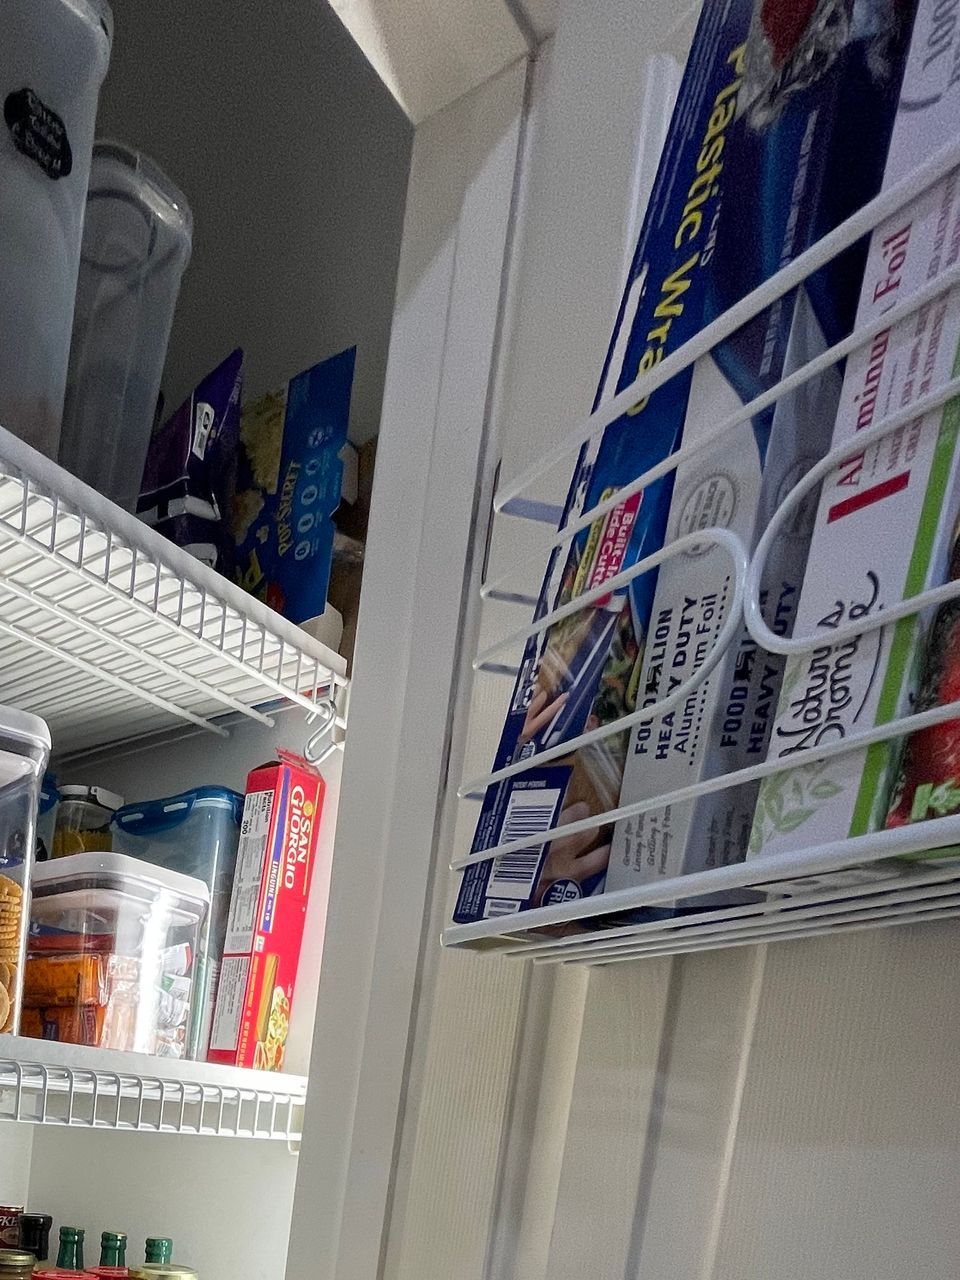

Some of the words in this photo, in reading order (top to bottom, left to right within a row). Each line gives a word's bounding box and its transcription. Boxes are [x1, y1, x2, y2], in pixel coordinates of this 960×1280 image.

[874, 221, 912, 304] Foil
[606, 501, 625, 539] lide
[651, 608, 673, 663] LION
[696, 594, 718, 636] Foil
[655, 676, 682, 760] HEAY
[672, 595, 698, 669] DUTY
[720, 687, 749, 748] FOOD
[747, 665, 779, 755] HEAVY
[285, 785, 305, 889] GIORGIO
[297, 816, 311, 864] SAN
[268, 860, 279, 899] LINGUINE
